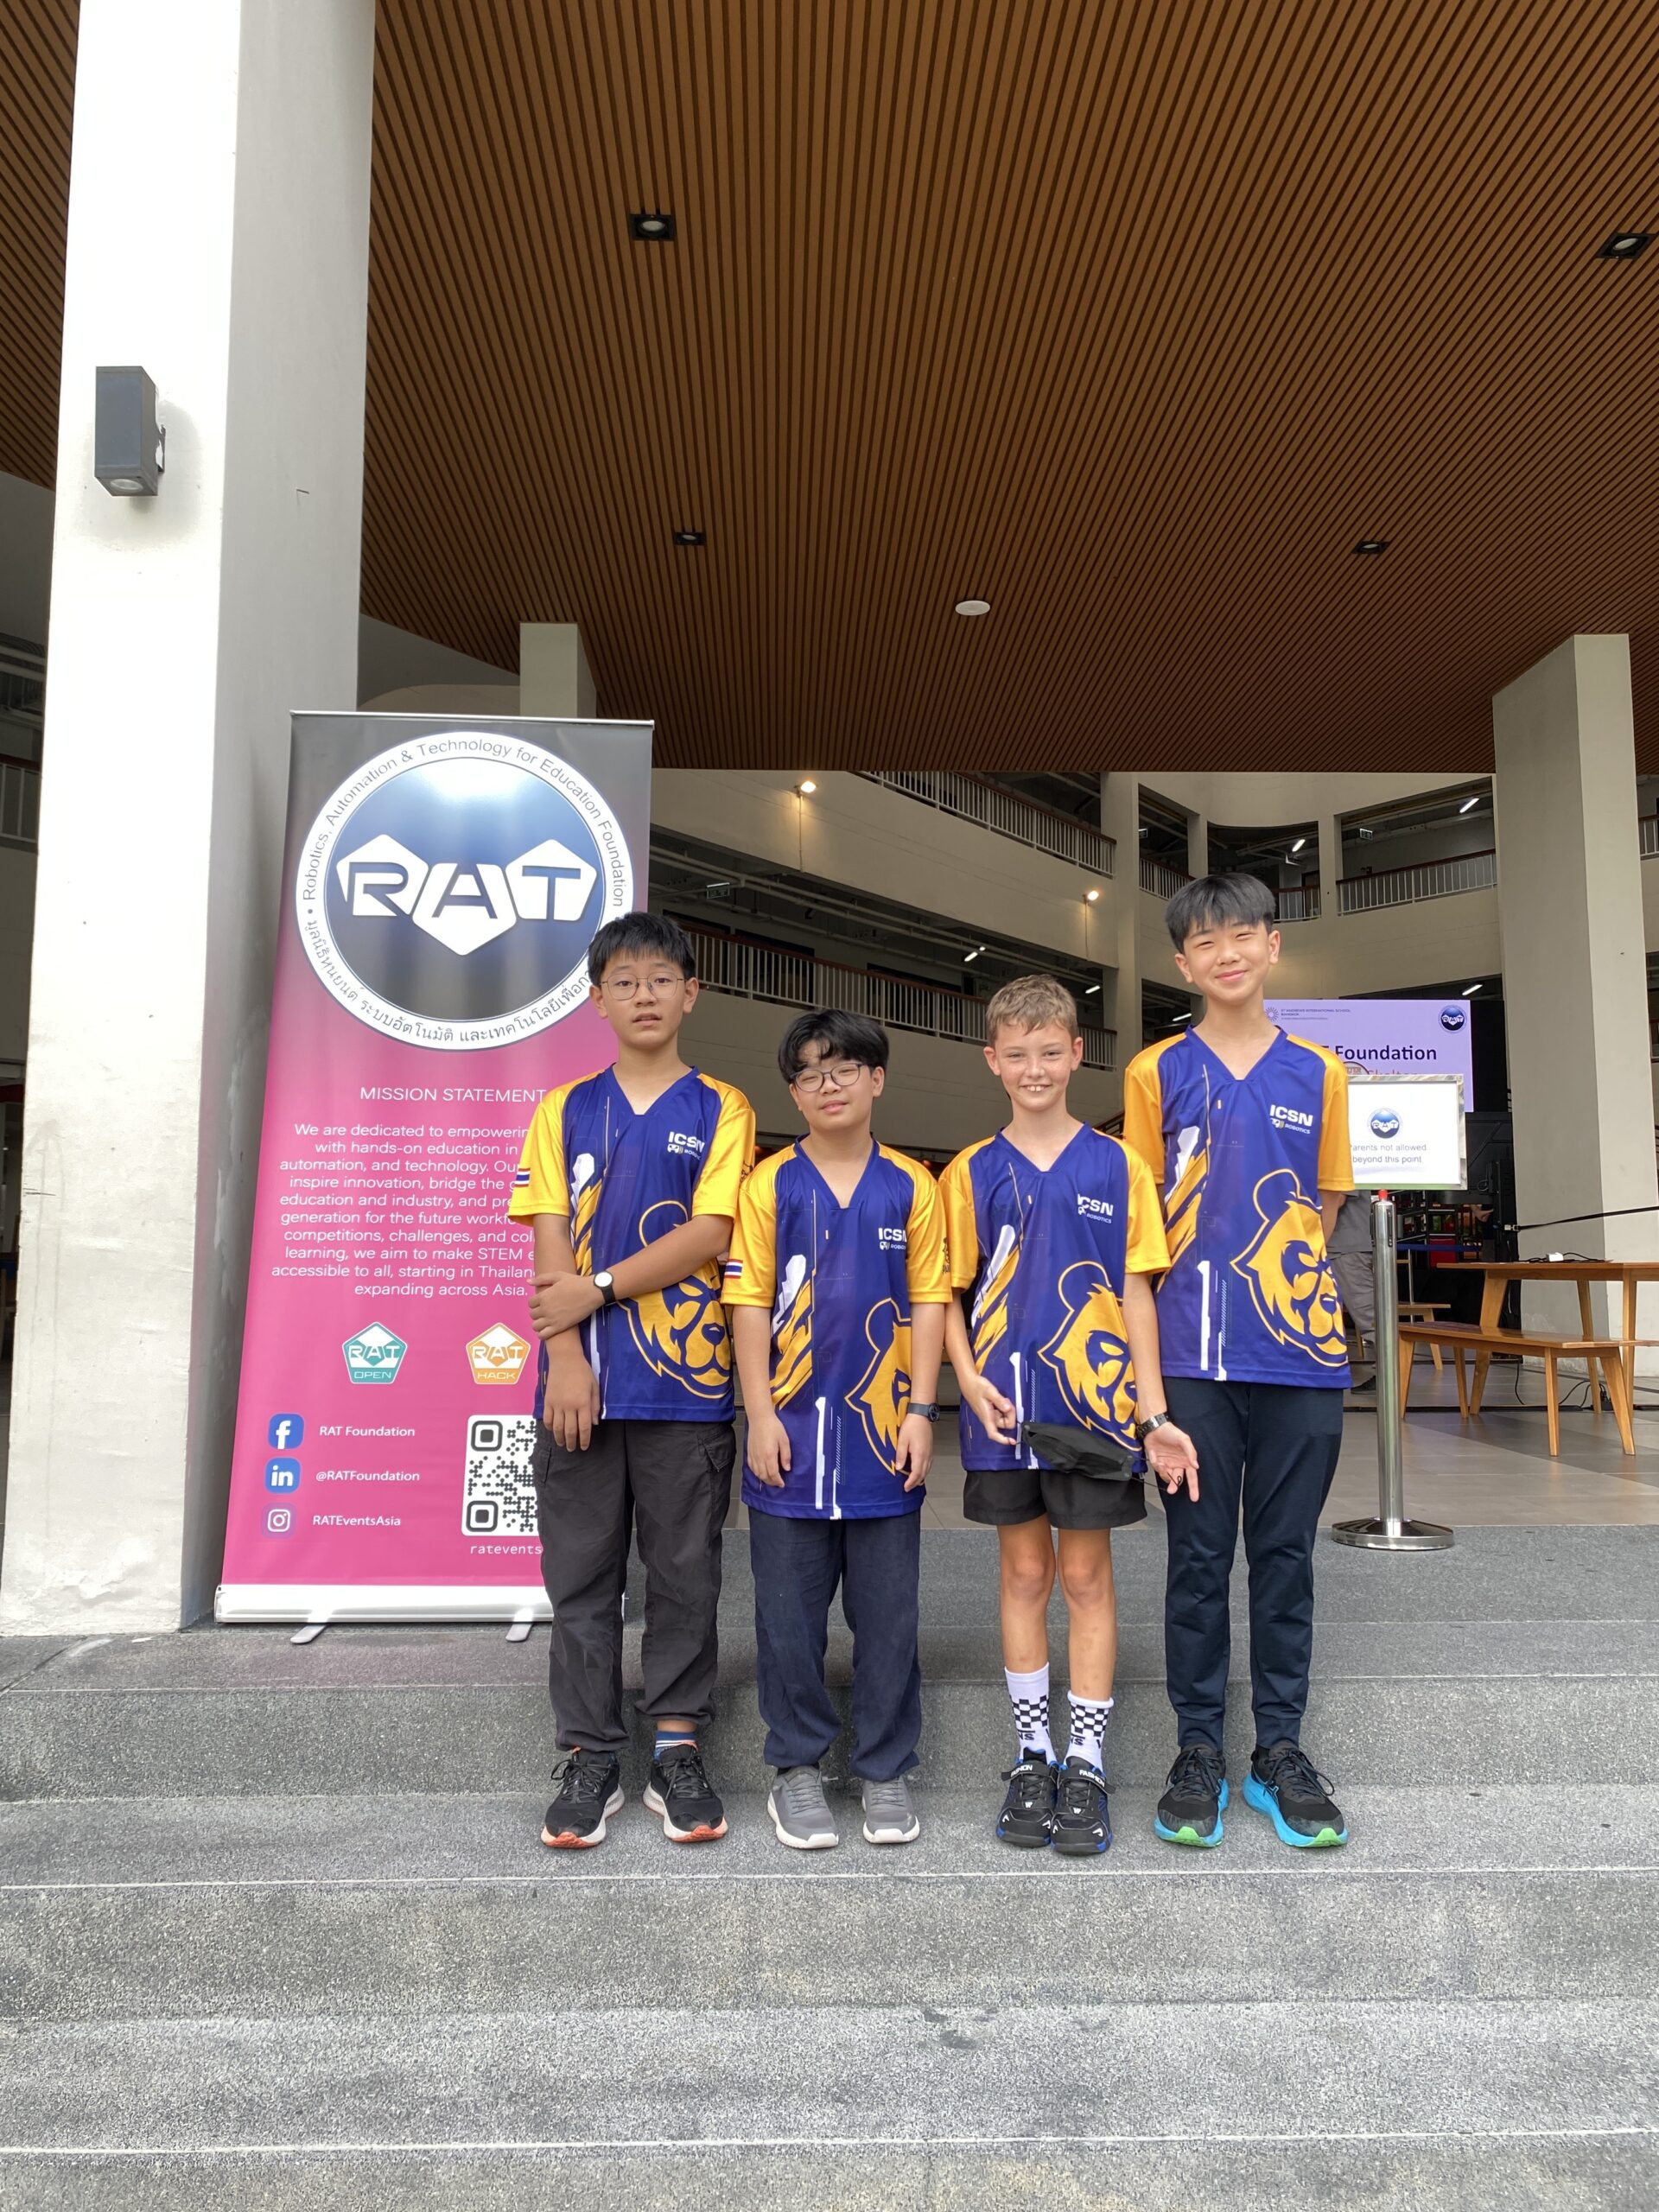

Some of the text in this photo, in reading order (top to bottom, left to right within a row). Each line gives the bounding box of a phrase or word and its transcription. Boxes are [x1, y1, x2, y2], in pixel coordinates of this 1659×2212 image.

[302, 739, 626, 907] Robotics, Automation & Technology for Education Foundation
[1335, 1045, 1437, 1060] Foundation
[361, 1087, 547, 1103] MISSION STATEMENT
[1269, 1104, 1313, 1127] ICSN
[296, 1124, 318, 1135] We
[351, 1124, 423, 1136] dedicated
[429, 1127, 442, 1136] to
[1284, 1123, 1311, 1135] ROBOTICS
[315, 1141, 518, 1154] with hands-on education in
[668, 1131, 705, 1153] ICSN
[280, 1159, 365, 1171] automation,
[372, 1160, 399, 1171] and
[405, 1160, 486, 1174] technology.
[1352, 1156, 1382, 1165] beyond
[1402, 1156, 1422, 1165] point
[290, 1176, 339, 1190] inspire
[344, 1176, 423, 1189] innovation,
[429, 1177, 475, 1192] bridge
[481, 1178, 504, 1189] the
[281, 1194, 353, 1205] education
[359, 1194, 386, 1205] and
[393, 1195, 453, 1209] industry,
[459, 1195, 486, 1206] and
[1077, 1193, 1114, 1217] ICSN
[282, 1211, 359, 1225] generation
[365, 1211, 385, 1223] for
[391, 1212, 413, 1224] the
[419, 1212, 461, 1224] future
[1086, 1213, 1112, 1224] ROBOTICS
[284, 1230, 384, 1243] competitions,
[390, 1230, 472, 1244] challenges,
[478, 1230, 505, 1242] and
[286, 1247, 348, 1262] learning,
[381, 1248, 407, 1258] aim
[414, 1249, 427, 1259] to
[433, 1249, 473, 1259] make
[478, 1248, 522, 1260] STEM
[272, 1265, 535, 1280] accessible to all, starting in Thailan
[355, 1283, 527, 1298] expanding across Asia.
[348, 1345, 401, 1359] RAT
[473, 1345, 524, 1360] RAT
[319, 1426, 416, 1437] RAT Foundation
[315, 1471, 420, 1483] @RATFoundation
[313, 1515, 402, 1527] RATEventsAsia
